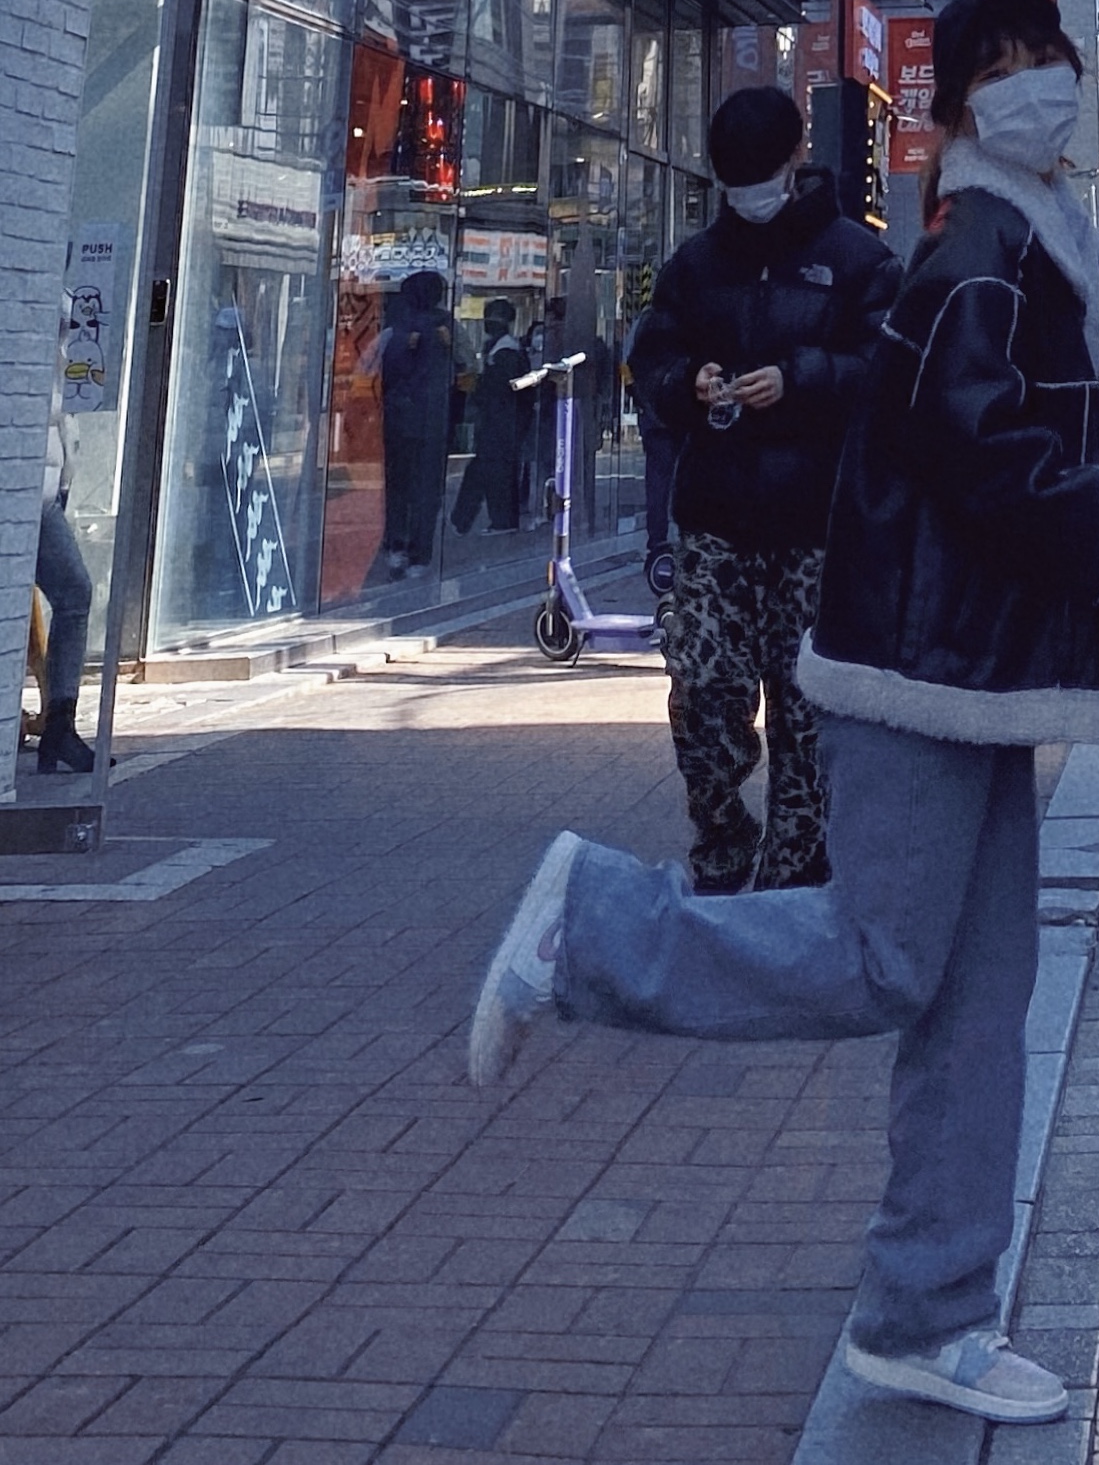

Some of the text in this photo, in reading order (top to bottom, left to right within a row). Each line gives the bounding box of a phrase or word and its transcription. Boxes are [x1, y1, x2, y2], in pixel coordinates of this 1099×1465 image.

[898, 65, 935, 85] 보드
[898, 88, 934, 111] 게임
[82, 242, 113, 255] PUSH
